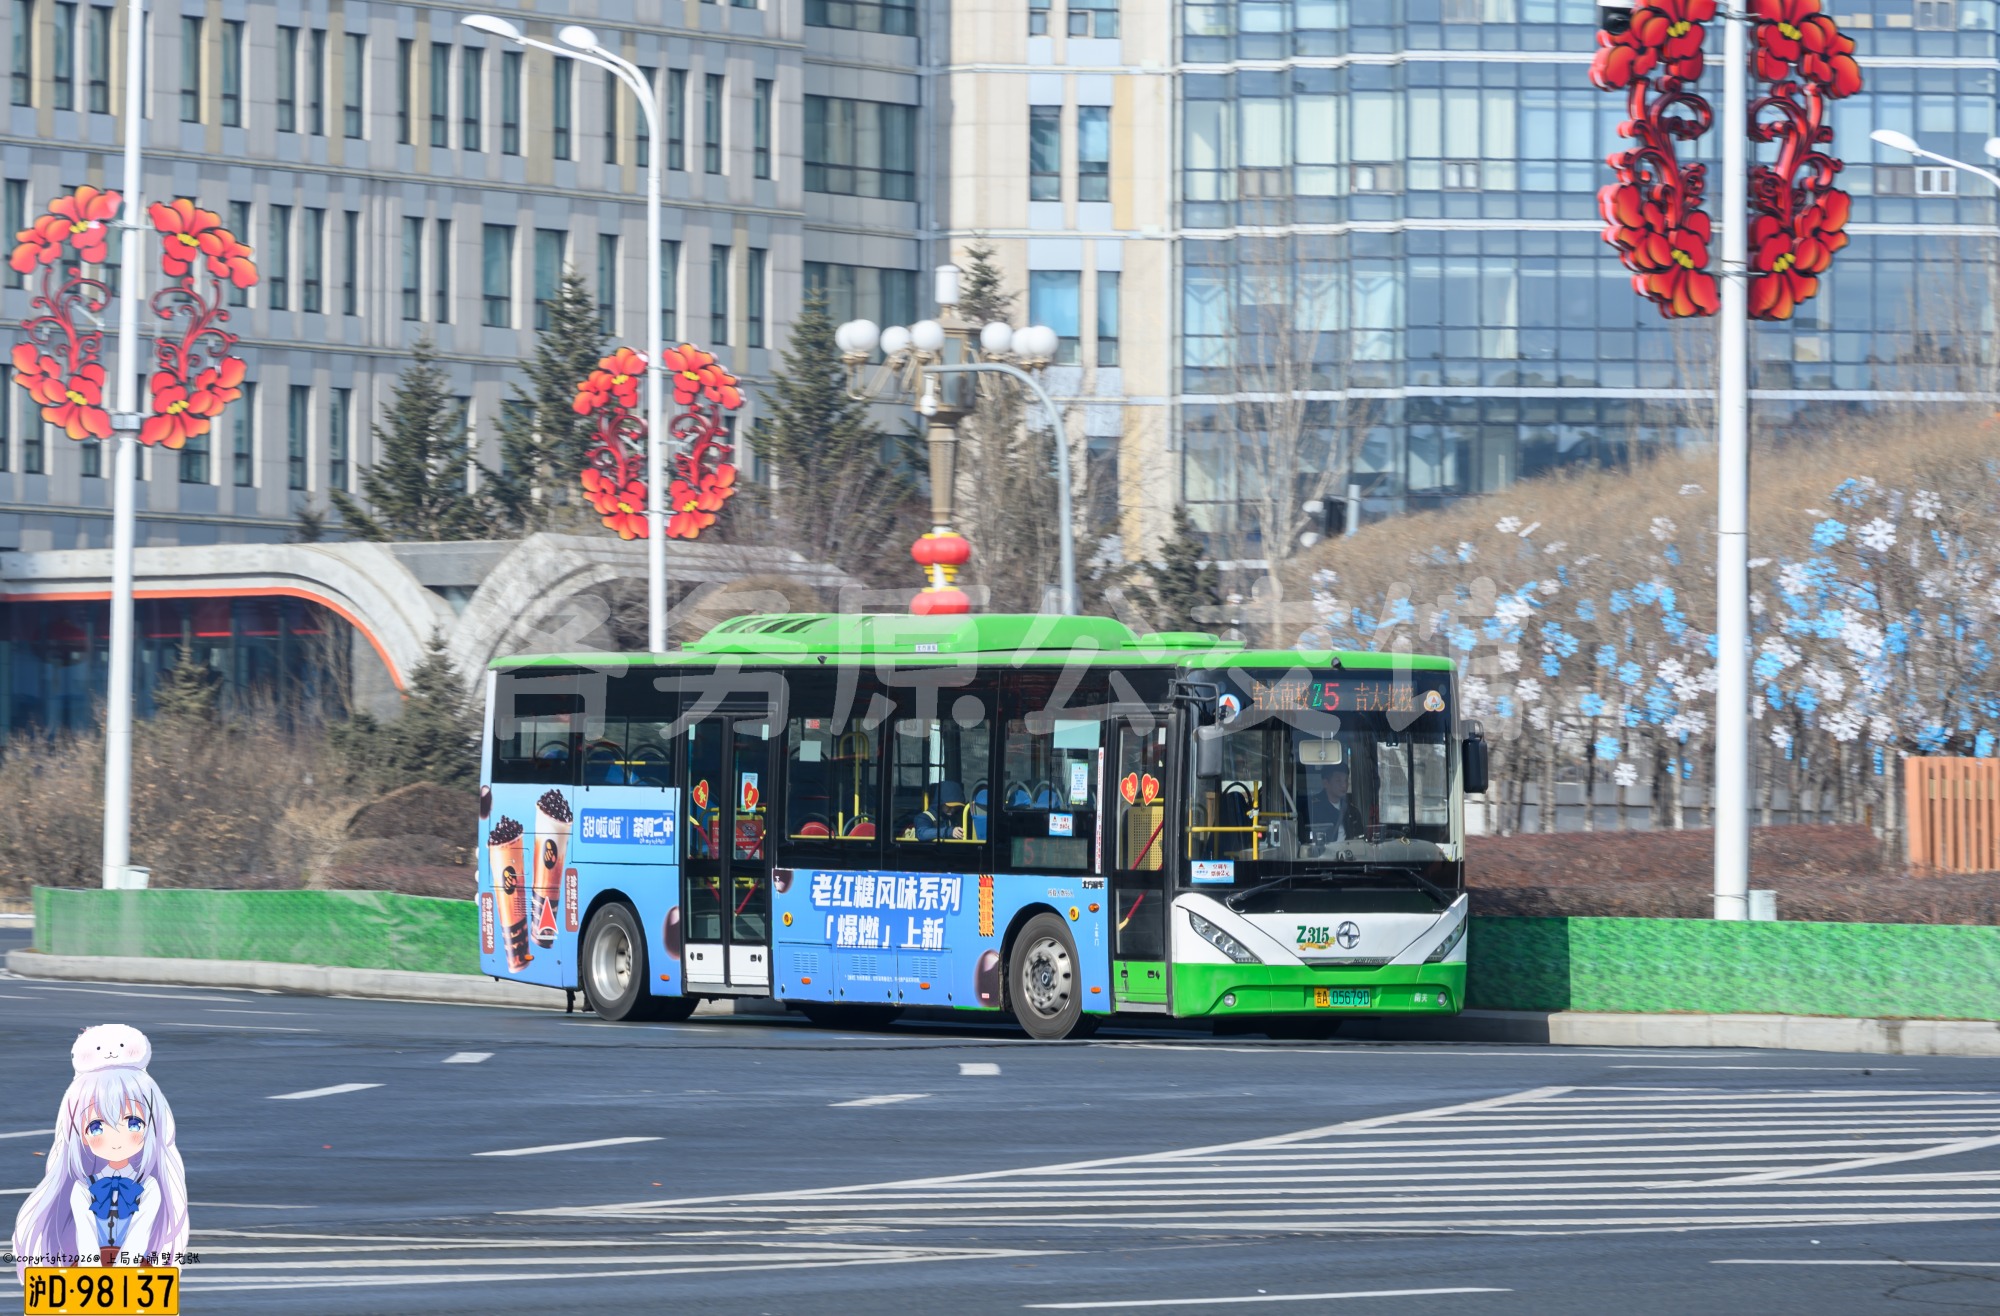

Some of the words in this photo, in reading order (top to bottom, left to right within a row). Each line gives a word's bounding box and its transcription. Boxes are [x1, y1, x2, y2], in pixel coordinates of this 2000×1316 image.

[1253, 680, 1310, 711] 吉大南校
[1354, 682, 1414, 712] 吉大北校
[582, 816, 622, 838] 甜啦啦
[633, 816, 673, 838] 茶啊二中
[812, 874, 962, 912] 老红糖风味系列
[1296, 925, 1330, 944] Z315
[1332, 990, 1370, 1005] 05679D
